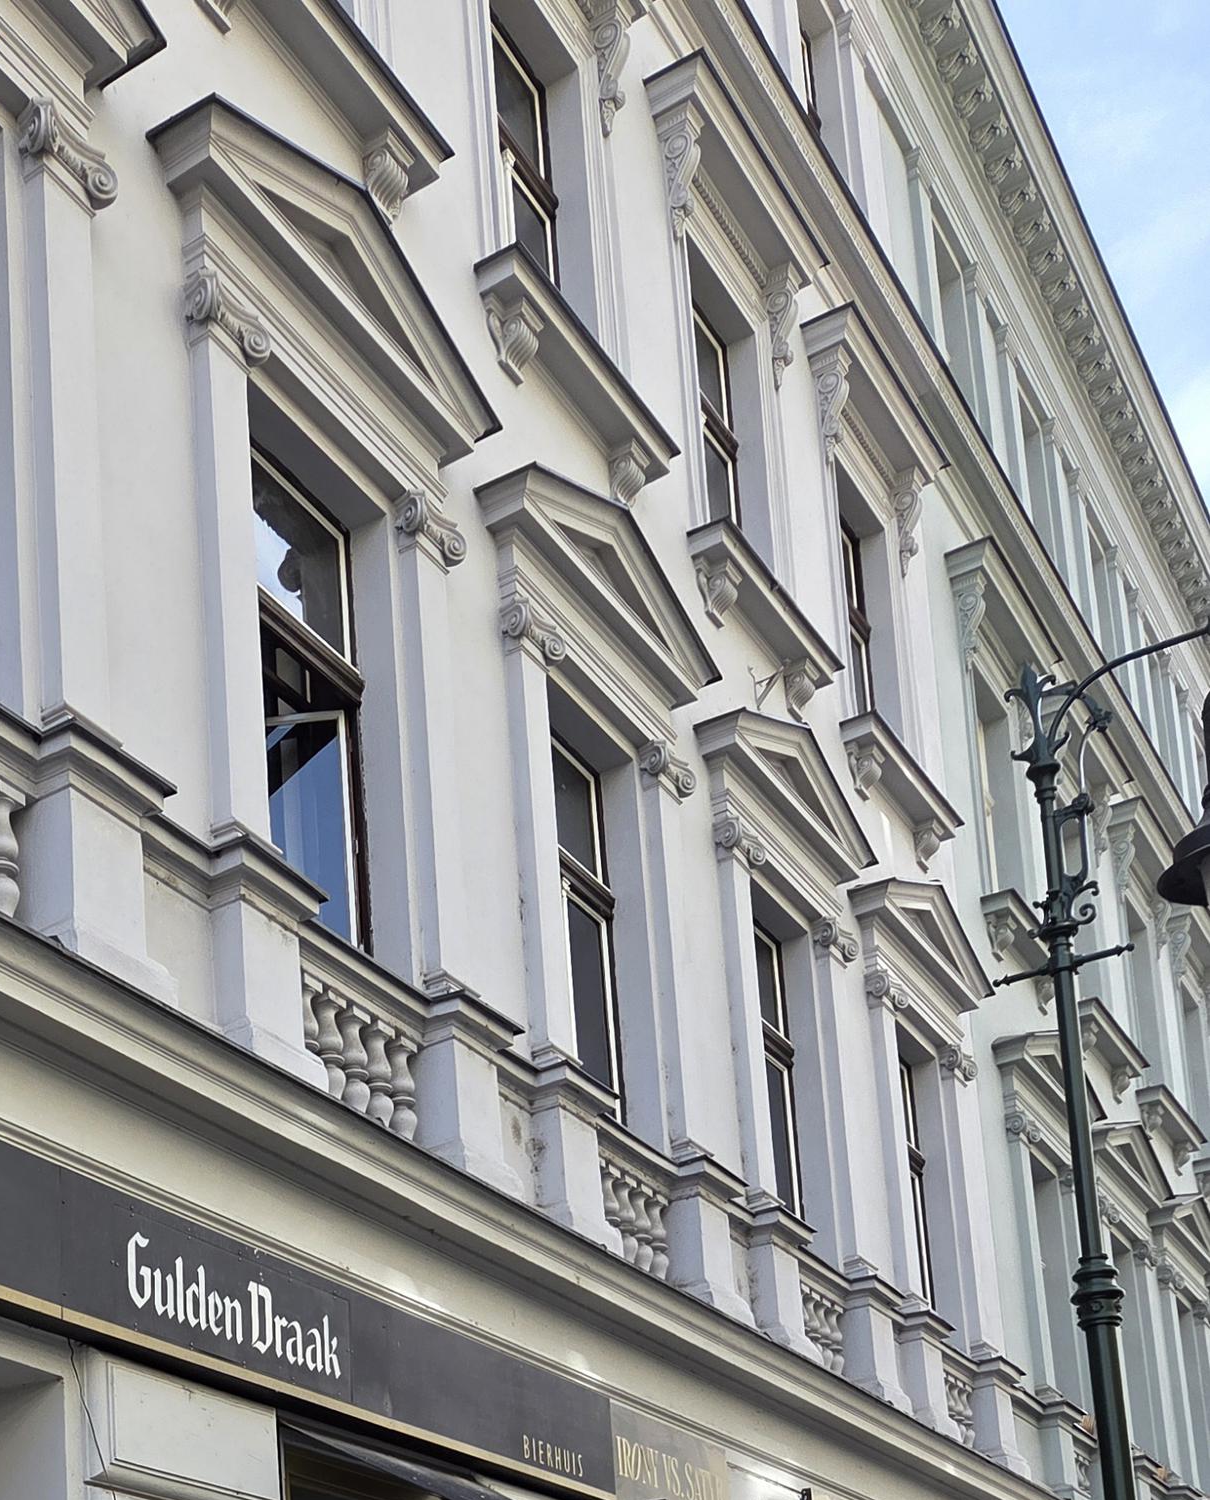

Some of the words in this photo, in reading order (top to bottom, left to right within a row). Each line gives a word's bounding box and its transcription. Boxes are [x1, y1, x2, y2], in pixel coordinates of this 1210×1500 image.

[127, 1231, 243, 1344] Gulden
[247, 1281, 341, 1379] Draak
[523, 1434, 583, 1477] BIERHUIS
[615, 1435, 658, 1488] IRONY
[662, 1453, 685, 1498] VS.
